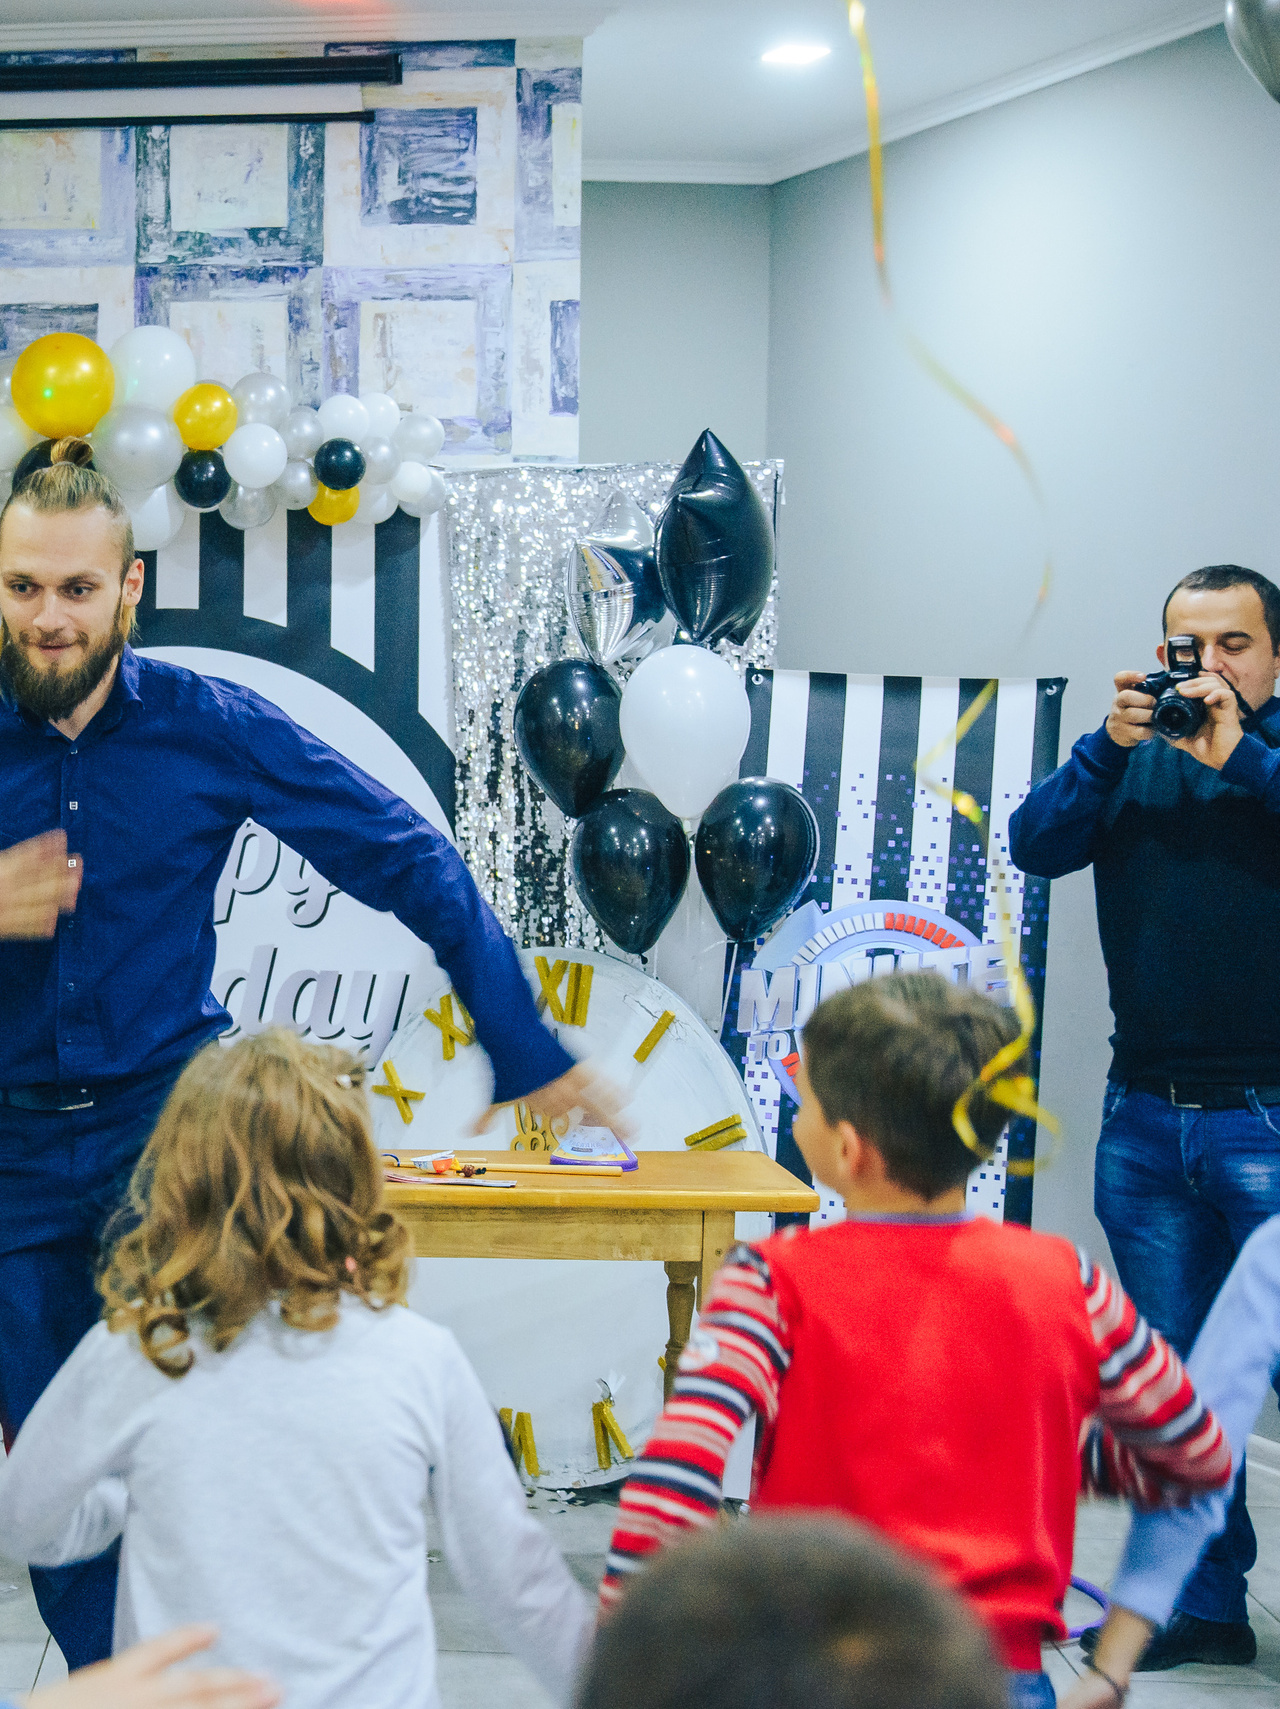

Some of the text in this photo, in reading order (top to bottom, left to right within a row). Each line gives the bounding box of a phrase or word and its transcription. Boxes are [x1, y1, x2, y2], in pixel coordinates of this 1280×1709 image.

[534, 956, 594, 1027] XII
[751, 1032, 791, 1062] TO
[372, 1060, 426, 1124] X
